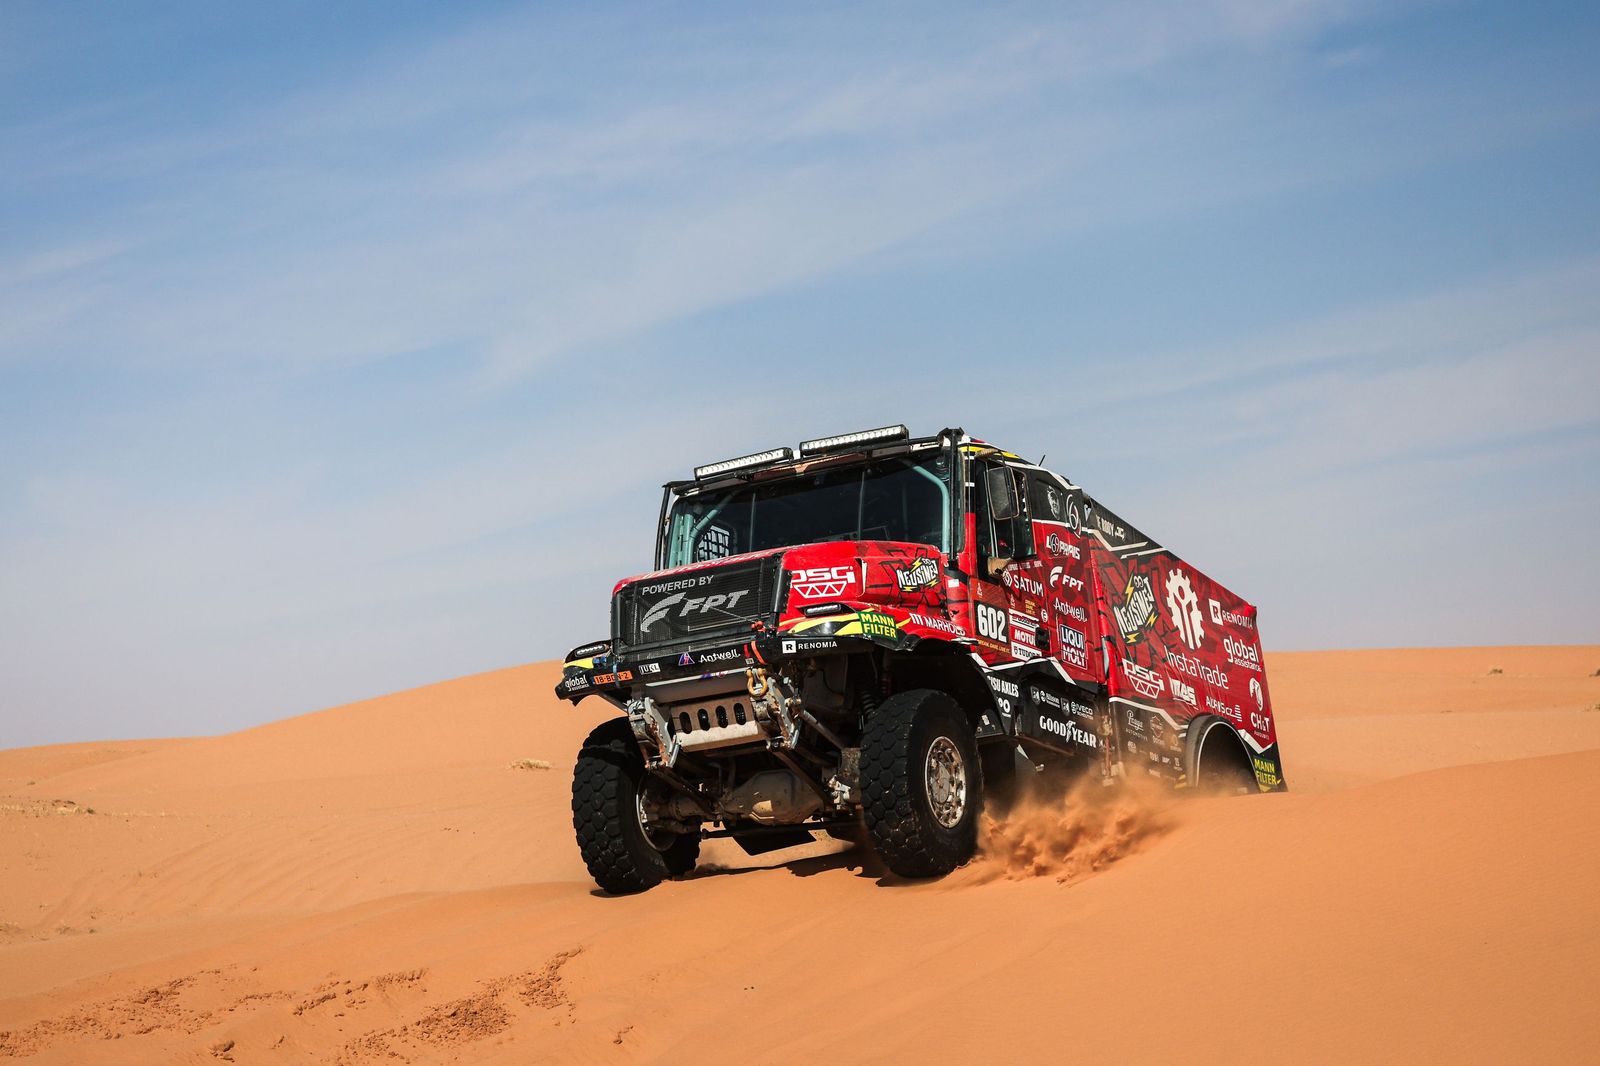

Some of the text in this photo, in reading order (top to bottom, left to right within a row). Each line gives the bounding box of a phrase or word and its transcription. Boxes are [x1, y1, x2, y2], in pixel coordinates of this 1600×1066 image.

[642, 574, 715, 596] POWERED BY
[1013, 574, 1044, 597] SATUM
[1062, 575, 1084, 592] FPT
[679, 590, 750, 617] FPT
[860, 613, 895, 628] MANN
[863, 624, 897, 639] FILTER
[923, 616, 966, 636] MARHOLD
[977, 603, 1007, 643] 602
[798, 641, 838, 650] RENOMIA
[1060, 626, 1085, 650] LIQUI
[1223, 635, 1259, 663] global
[1062, 645, 1085, 667] MOLY
[1122, 657, 1165, 691] PSG
[1163, 645, 1229, 690] InstaTrade
[564, 674, 588, 691] global
[1001, 680, 1019, 698] AXLES
[1039, 715, 1097, 748] GOODYEAR
[1254, 759, 1275, 773] MANN
[1256, 770, 1277, 785] FILTER
